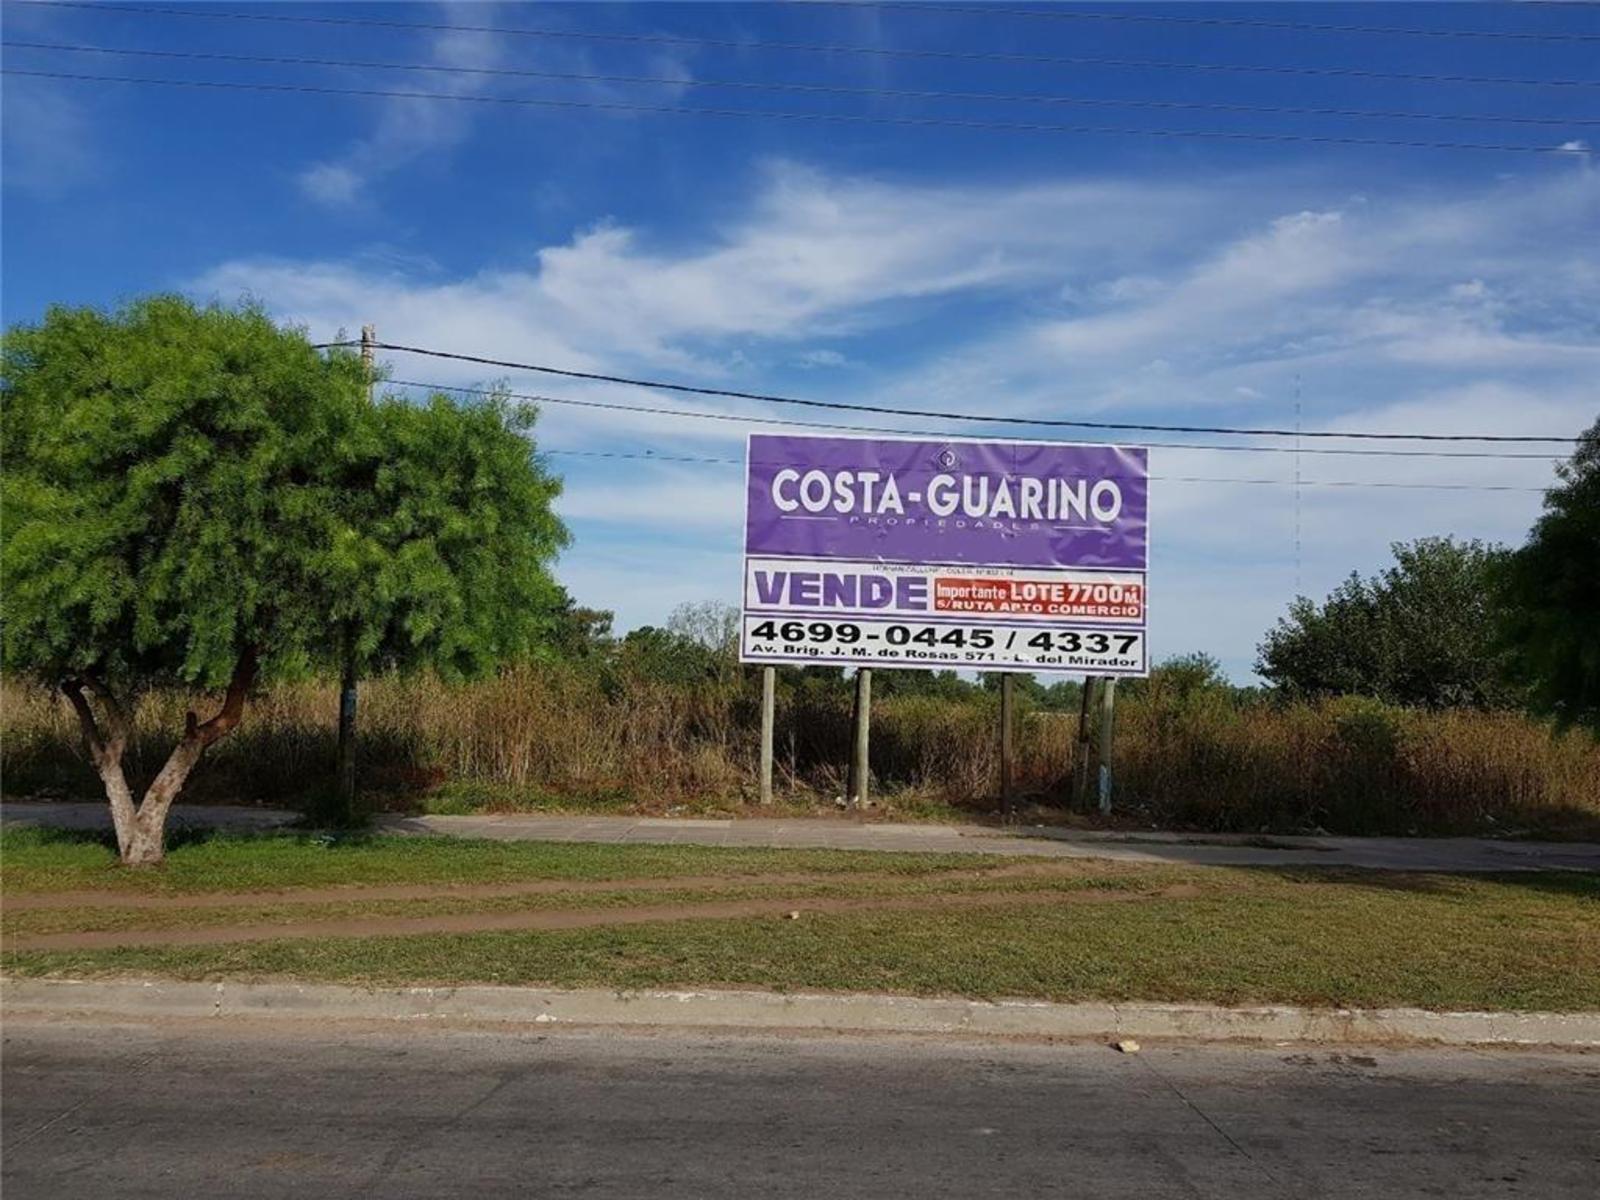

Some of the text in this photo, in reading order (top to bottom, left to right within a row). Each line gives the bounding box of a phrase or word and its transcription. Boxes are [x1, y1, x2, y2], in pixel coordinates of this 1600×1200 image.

[772, 469, 1122, 522] COSTA-GUARINO
[754, 571, 928, 610] VENDE
[937, 583, 1007, 600] Importante
[1011, 583, 1065, 602] LOTE
[1000, 602, 1043, 613] APTO
[1048, 604, 1139, 617] COMERCIO
[751, 621, 994, 649] 4699-0445
[1027, 631, 1138, 654] 4337
[752, 644, 777, 654] Av.
[784, 645, 824, 656] Brig.
[830, 647, 845, 656] J.
[852, 648, 872, 657] M.
[878, 648, 899, 658] de
[905, 649, 958, 660] Rosas
[965, 651, 995, 661] 571
[1035, 654, 1062, 664] del
[1069, 656, 1138, 667] Mirador
